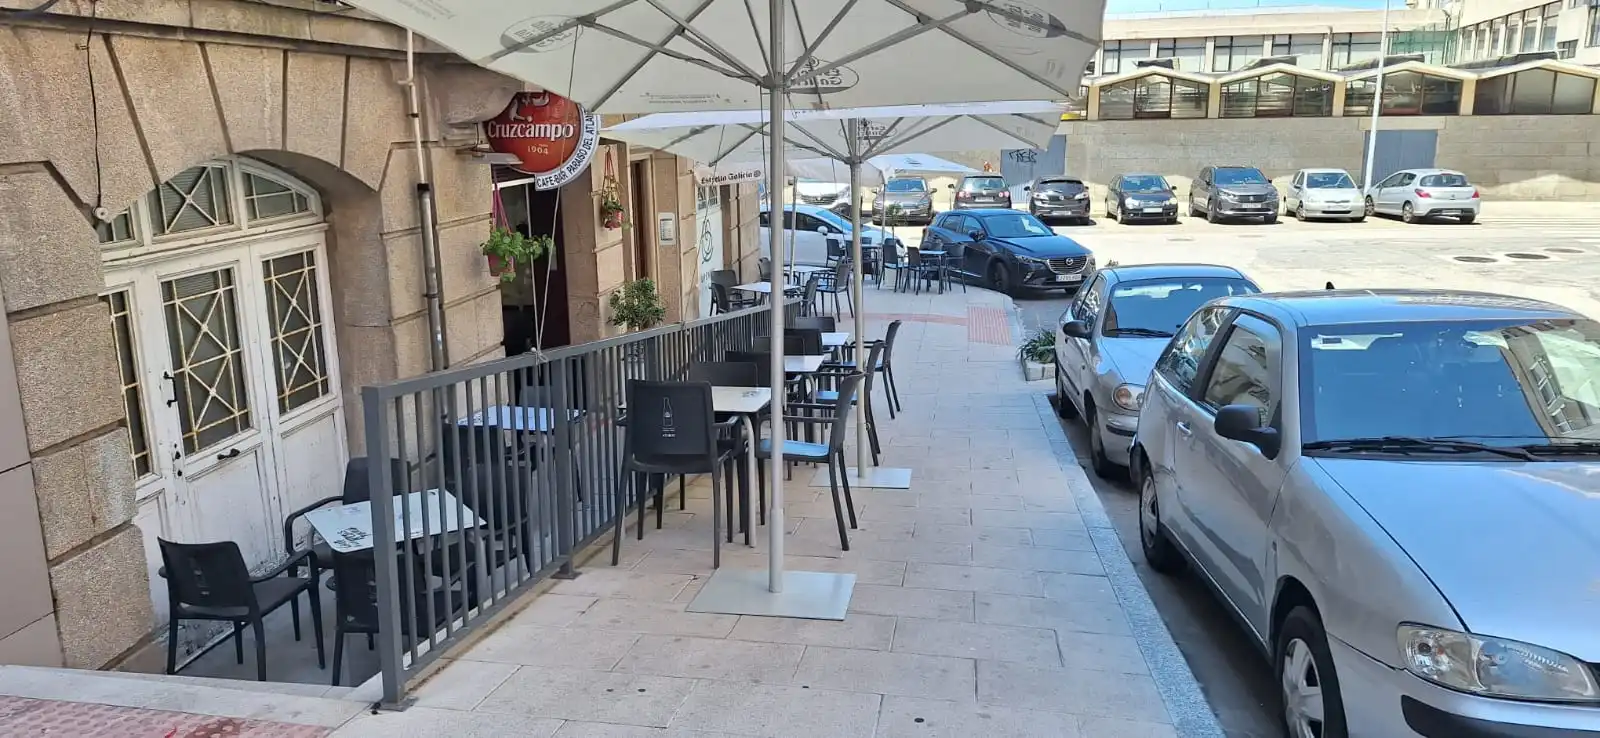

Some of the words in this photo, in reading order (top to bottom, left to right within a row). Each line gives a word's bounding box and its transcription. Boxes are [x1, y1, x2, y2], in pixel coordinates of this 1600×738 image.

[487, 120, 575, 142] Cruzcampo
[527, 145, 549, 155] 1904
[536, 170, 569, 188] CAFE-BAR
[566, 148, 588, 175] PARAISO
[584, 137, 593, 151] DEL
